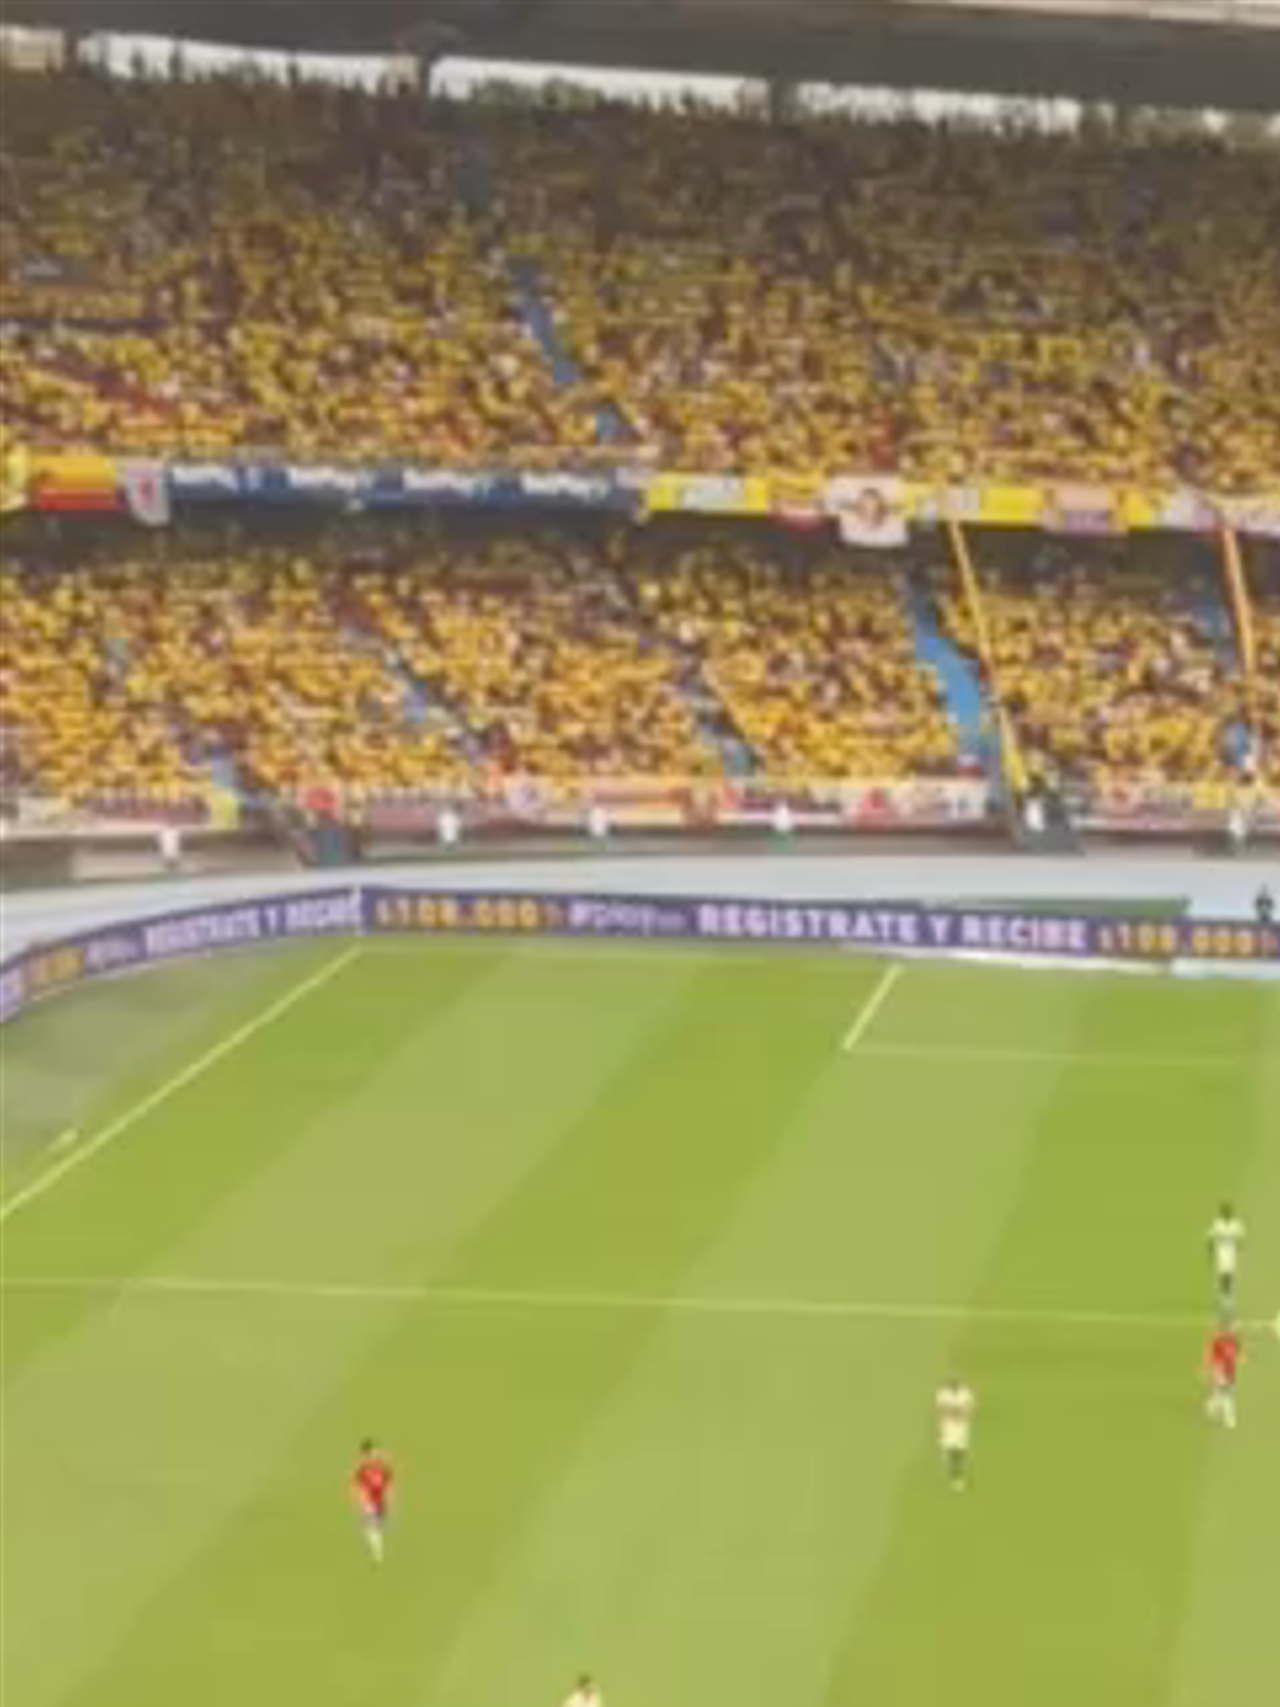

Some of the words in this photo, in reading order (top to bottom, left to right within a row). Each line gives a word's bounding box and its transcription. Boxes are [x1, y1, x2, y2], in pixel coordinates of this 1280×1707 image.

[700, 904, 918, 943] REGISTRATE
[930, 914, 951, 944] Y
[962, 914, 1087, 949] RECIBE
